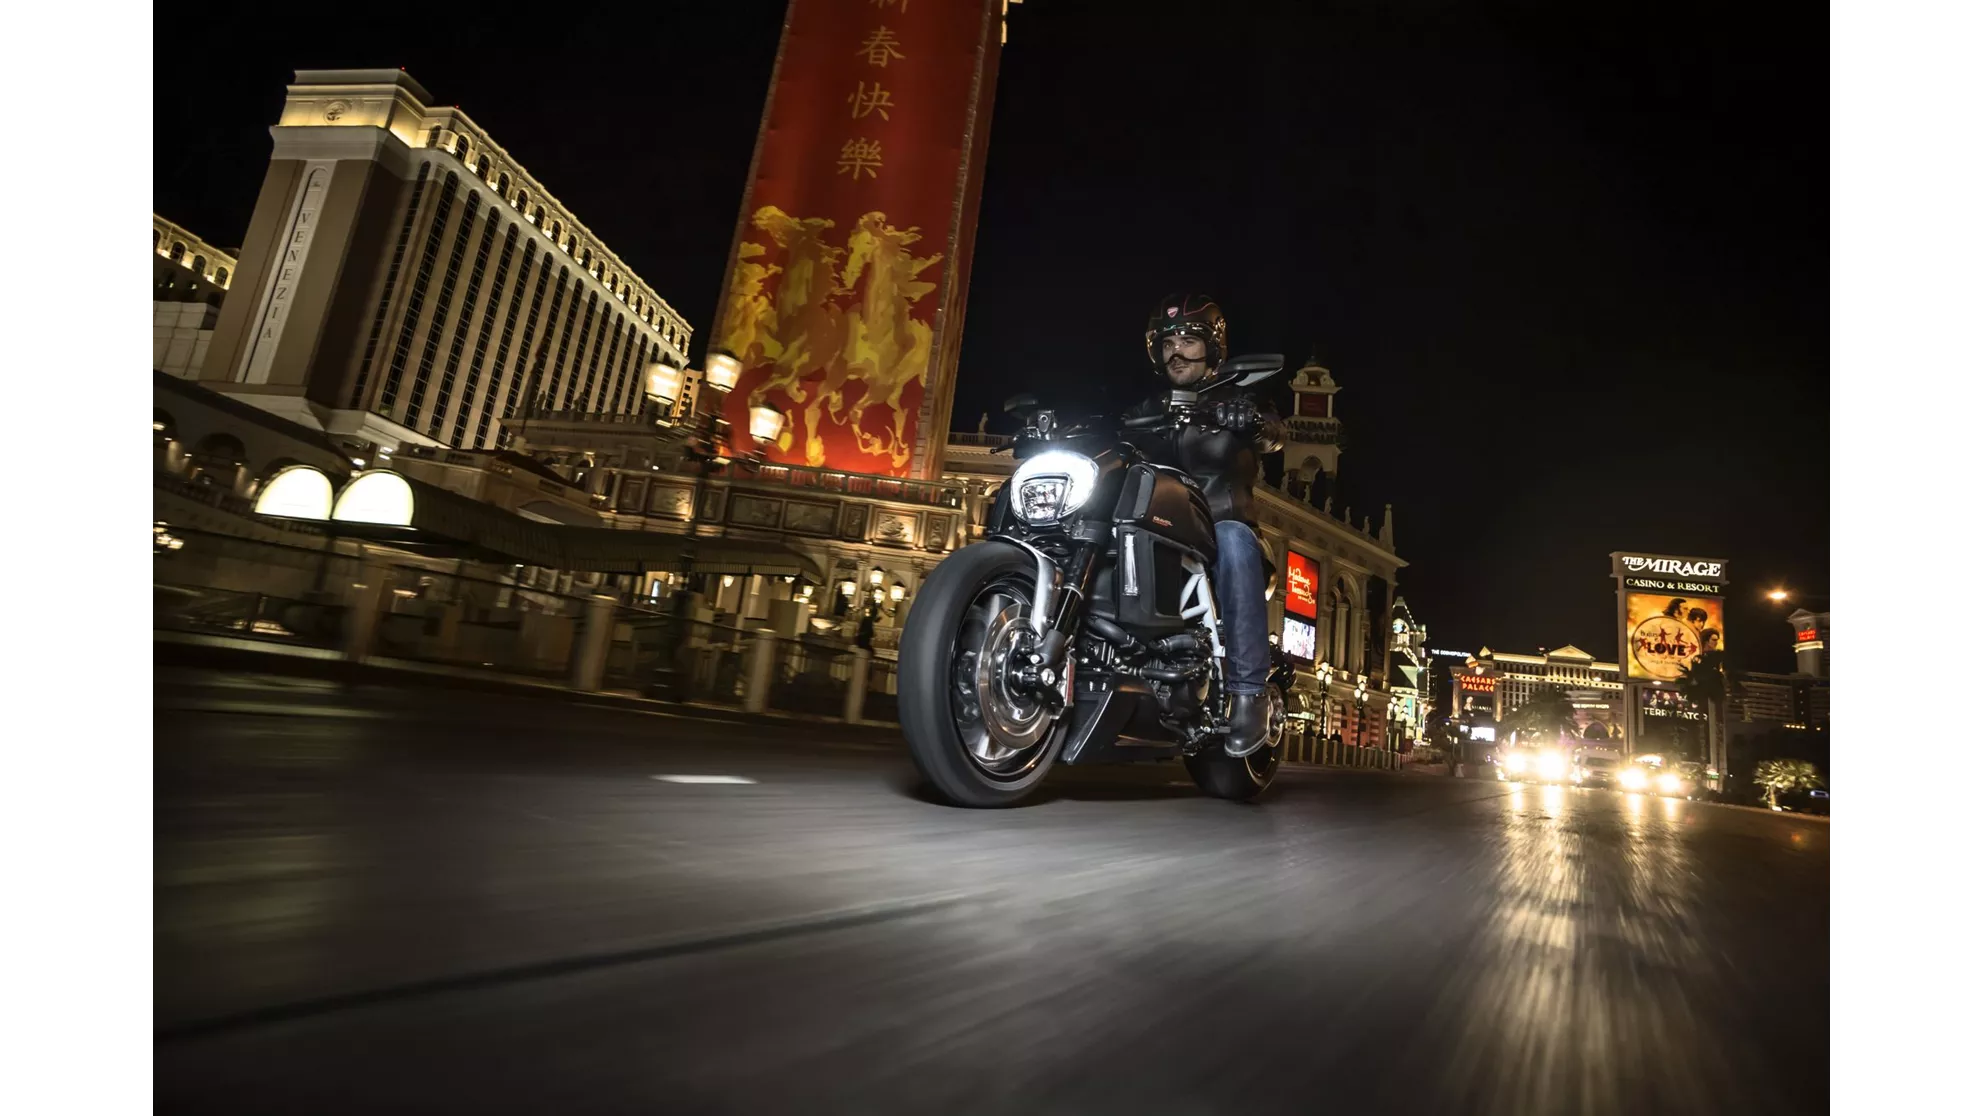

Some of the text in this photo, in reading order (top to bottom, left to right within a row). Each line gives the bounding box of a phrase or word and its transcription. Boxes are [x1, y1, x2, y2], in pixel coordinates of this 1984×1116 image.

[263, 212, 311, 339] VENEZIA
[1622, 556, 1721, 577] THE MIRAGE
[1626, 578, 1719, 593] CASINO & RESORT
[1647, 642, 1686, 656] LOVE
[1461, 675, 1496, 685] CAESARS
[1462, 683, 1494, 692] PALACE
[1643, 707, 1674, 717] TERRY
